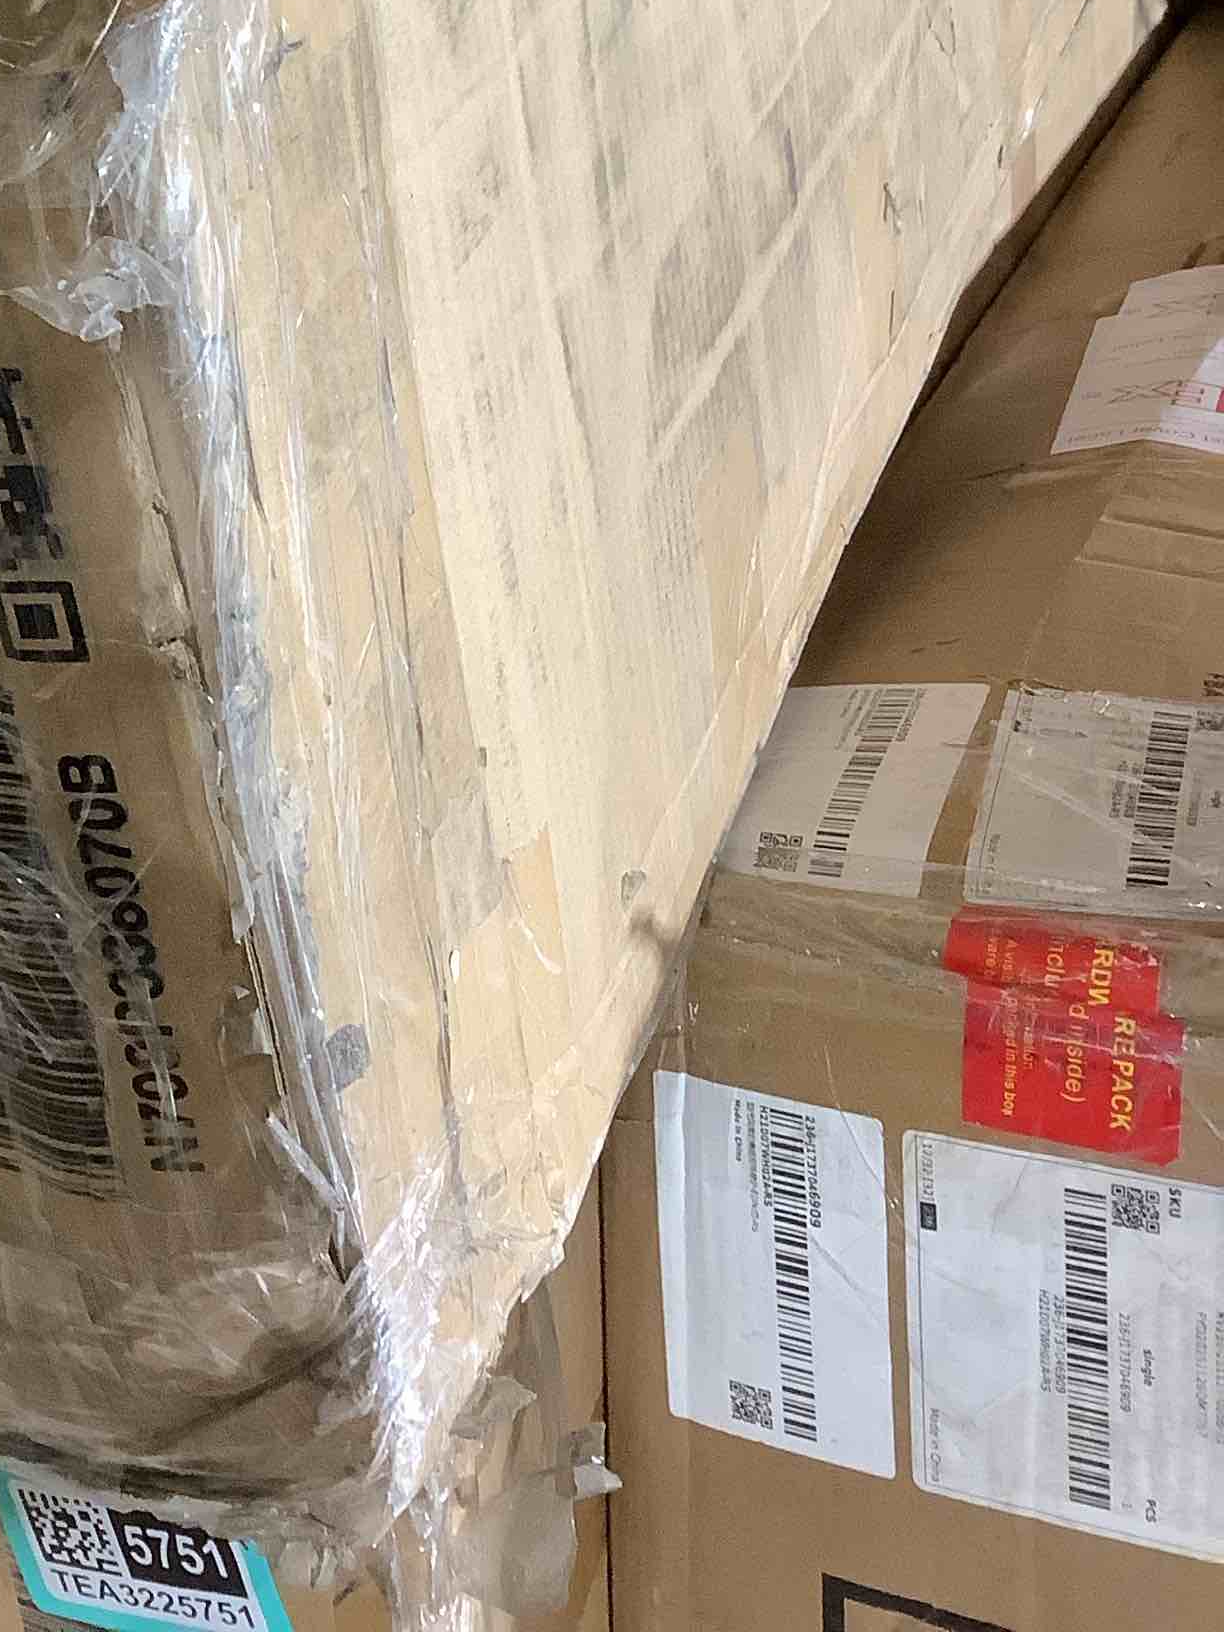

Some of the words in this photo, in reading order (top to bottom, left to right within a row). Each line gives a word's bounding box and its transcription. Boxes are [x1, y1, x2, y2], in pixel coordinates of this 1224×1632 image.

[57, 753, 205, 1173] N709P338070B
[1168, 1186, 1182, 1219] SKU
[1142, 1348, 1155, 1388] single
[1144, 1498, 1158, 1524] PCS
[124, 1524, 229, 1579] 5751
[50, 1569, 256, 1630] TEA3225751
